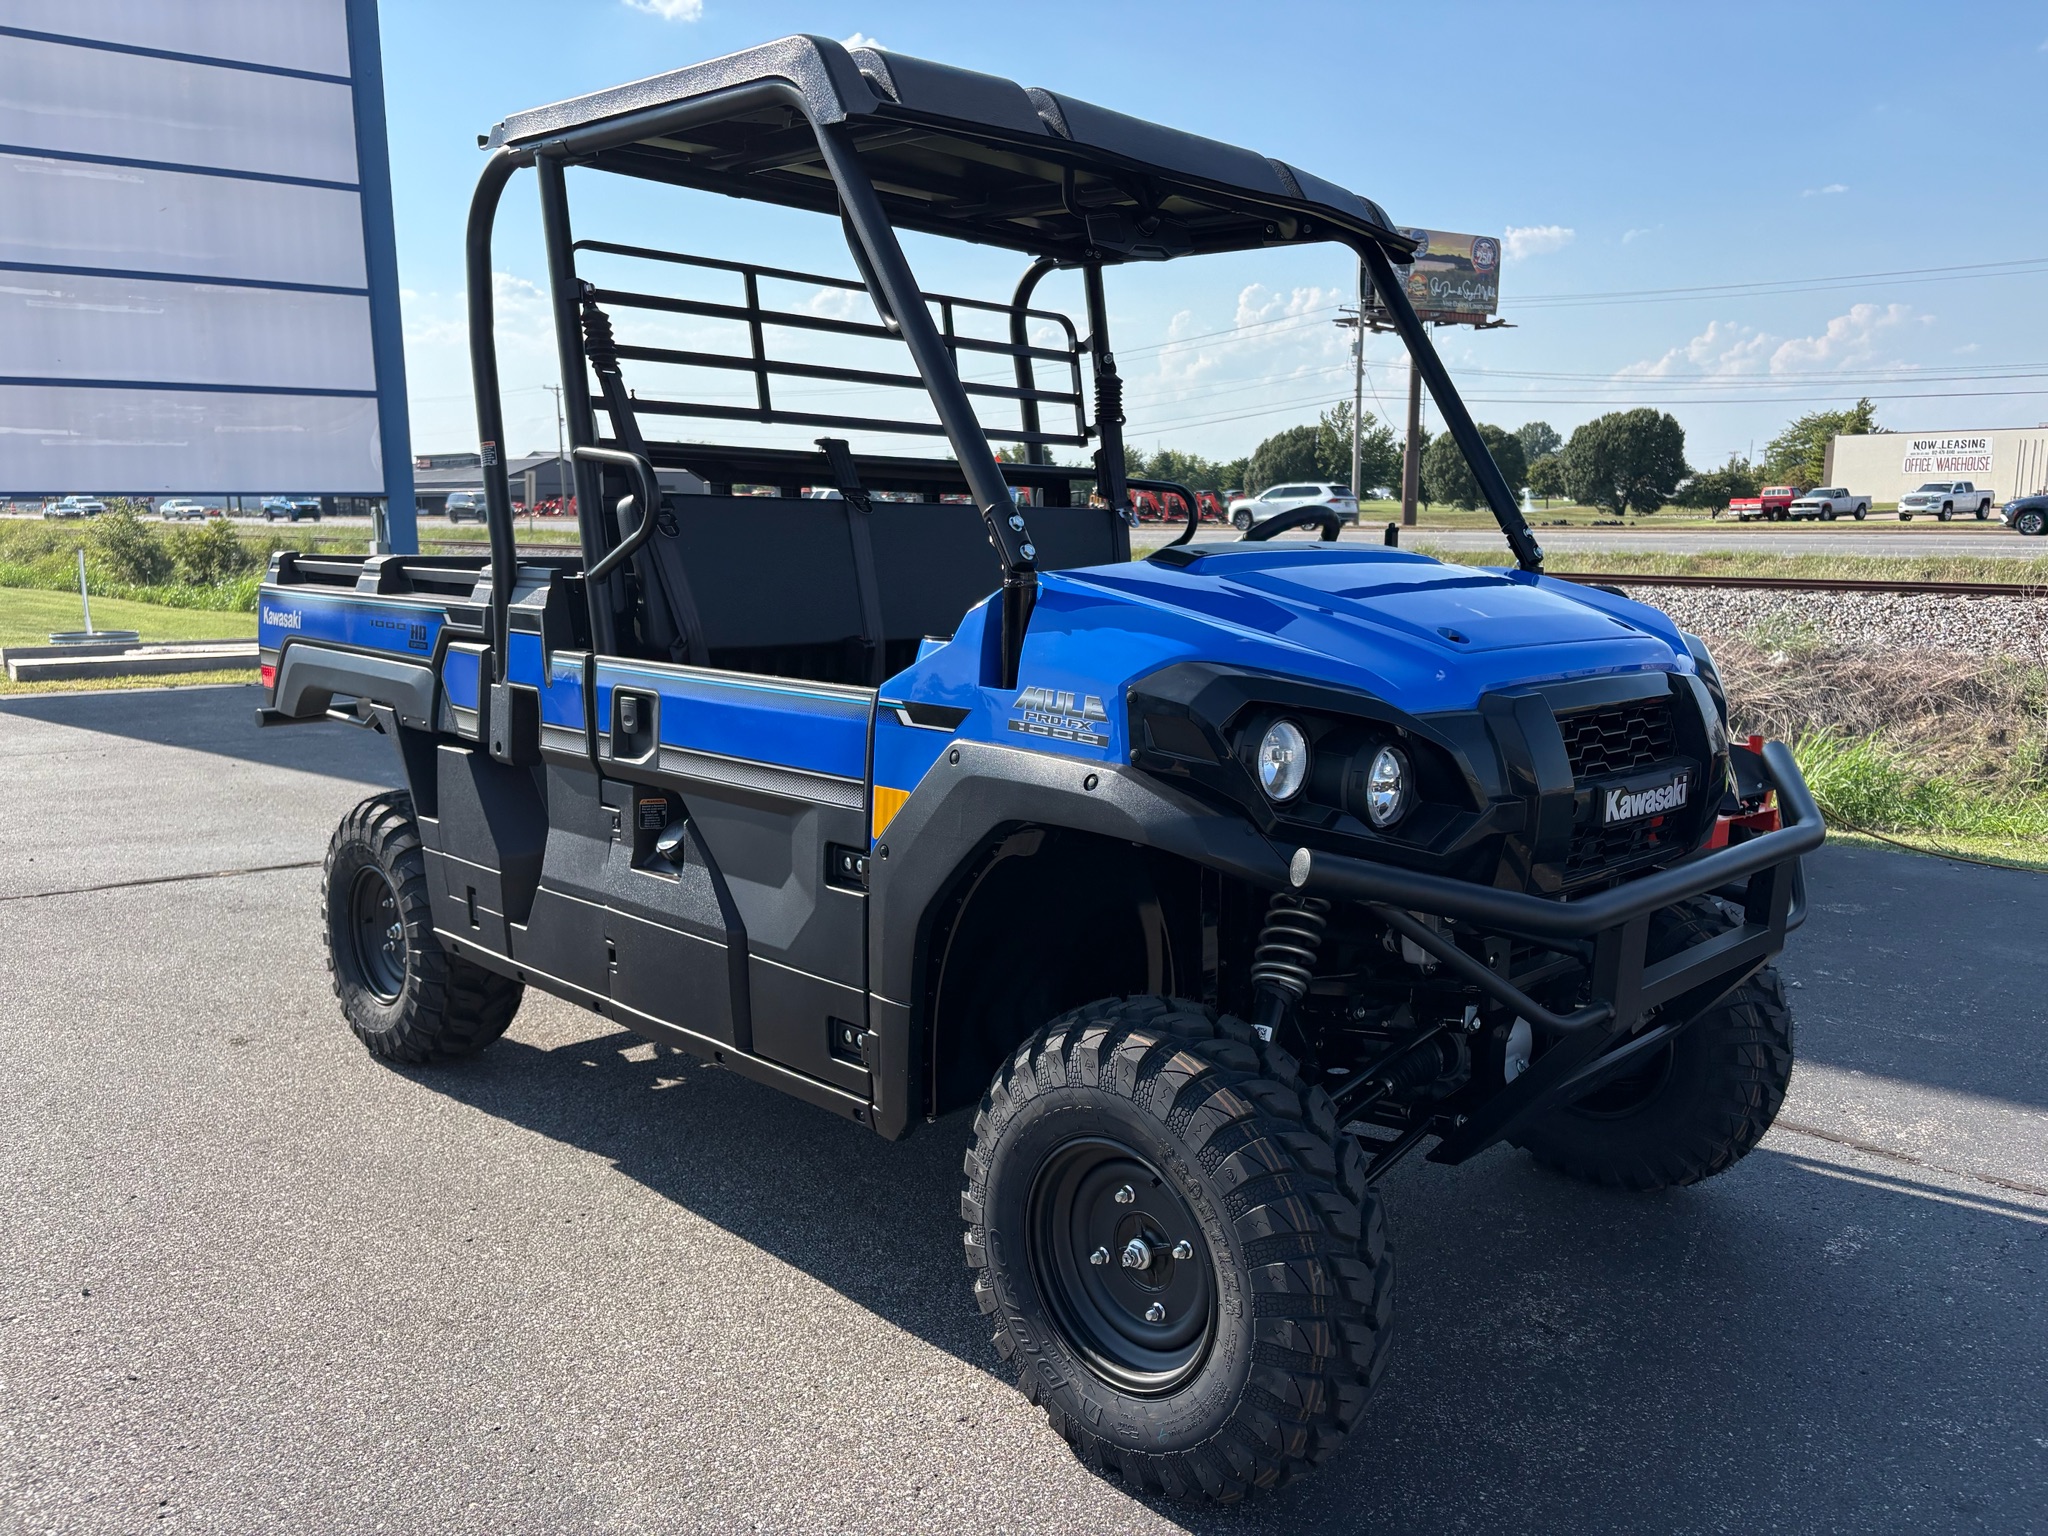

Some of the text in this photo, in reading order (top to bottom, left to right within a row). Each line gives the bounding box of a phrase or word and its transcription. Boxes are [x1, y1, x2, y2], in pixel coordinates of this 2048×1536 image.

[1913, 438, 1986, 451] NOW LEASING
[263, 606, 301, 629] Kawasaki
[410, 624, 427, 641] HD
[1012, 685, 1109, 723] MULE
[1018, 722, 1098, 744] 1000
[1605, 775, 1687, 823] Kawasaki
